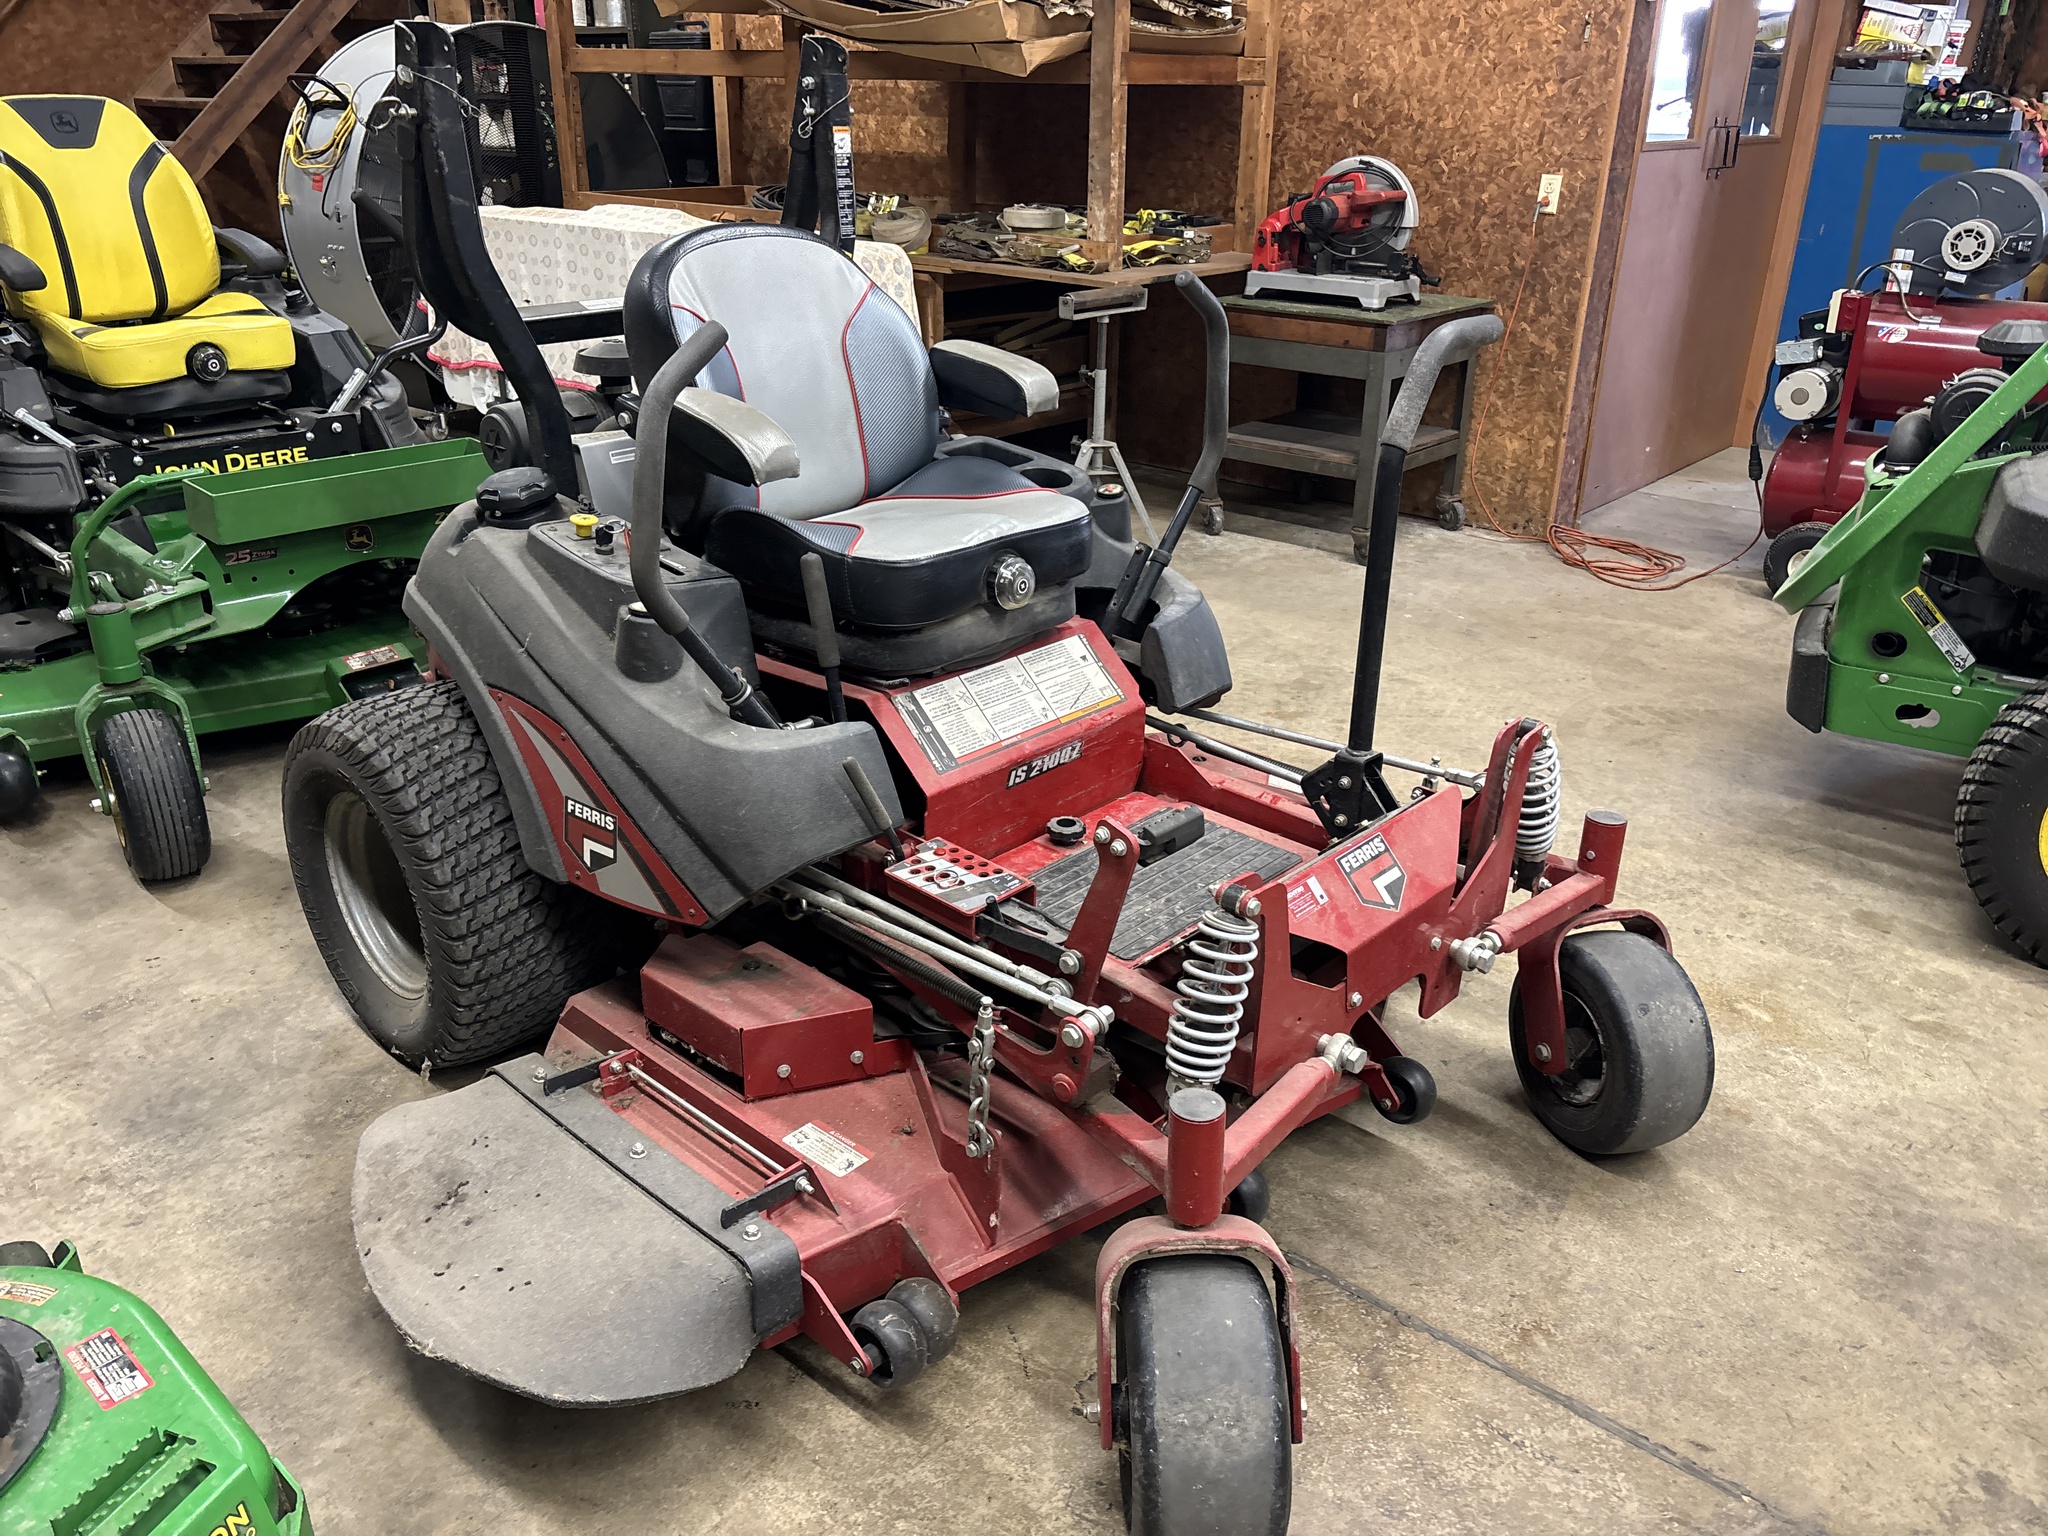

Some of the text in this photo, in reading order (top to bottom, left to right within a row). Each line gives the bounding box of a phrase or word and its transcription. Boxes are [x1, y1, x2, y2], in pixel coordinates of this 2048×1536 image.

[225, 446, 309, 472] DEERE
[225, 549, 251, 566] 25
[1007, 740, 1083, 787] IS 2100Z
[567, 799, 615, 831] FERRIS
[1340, 837, 1386, 873] FERRIS
[834, 1132, 857, 1147] DANGER
